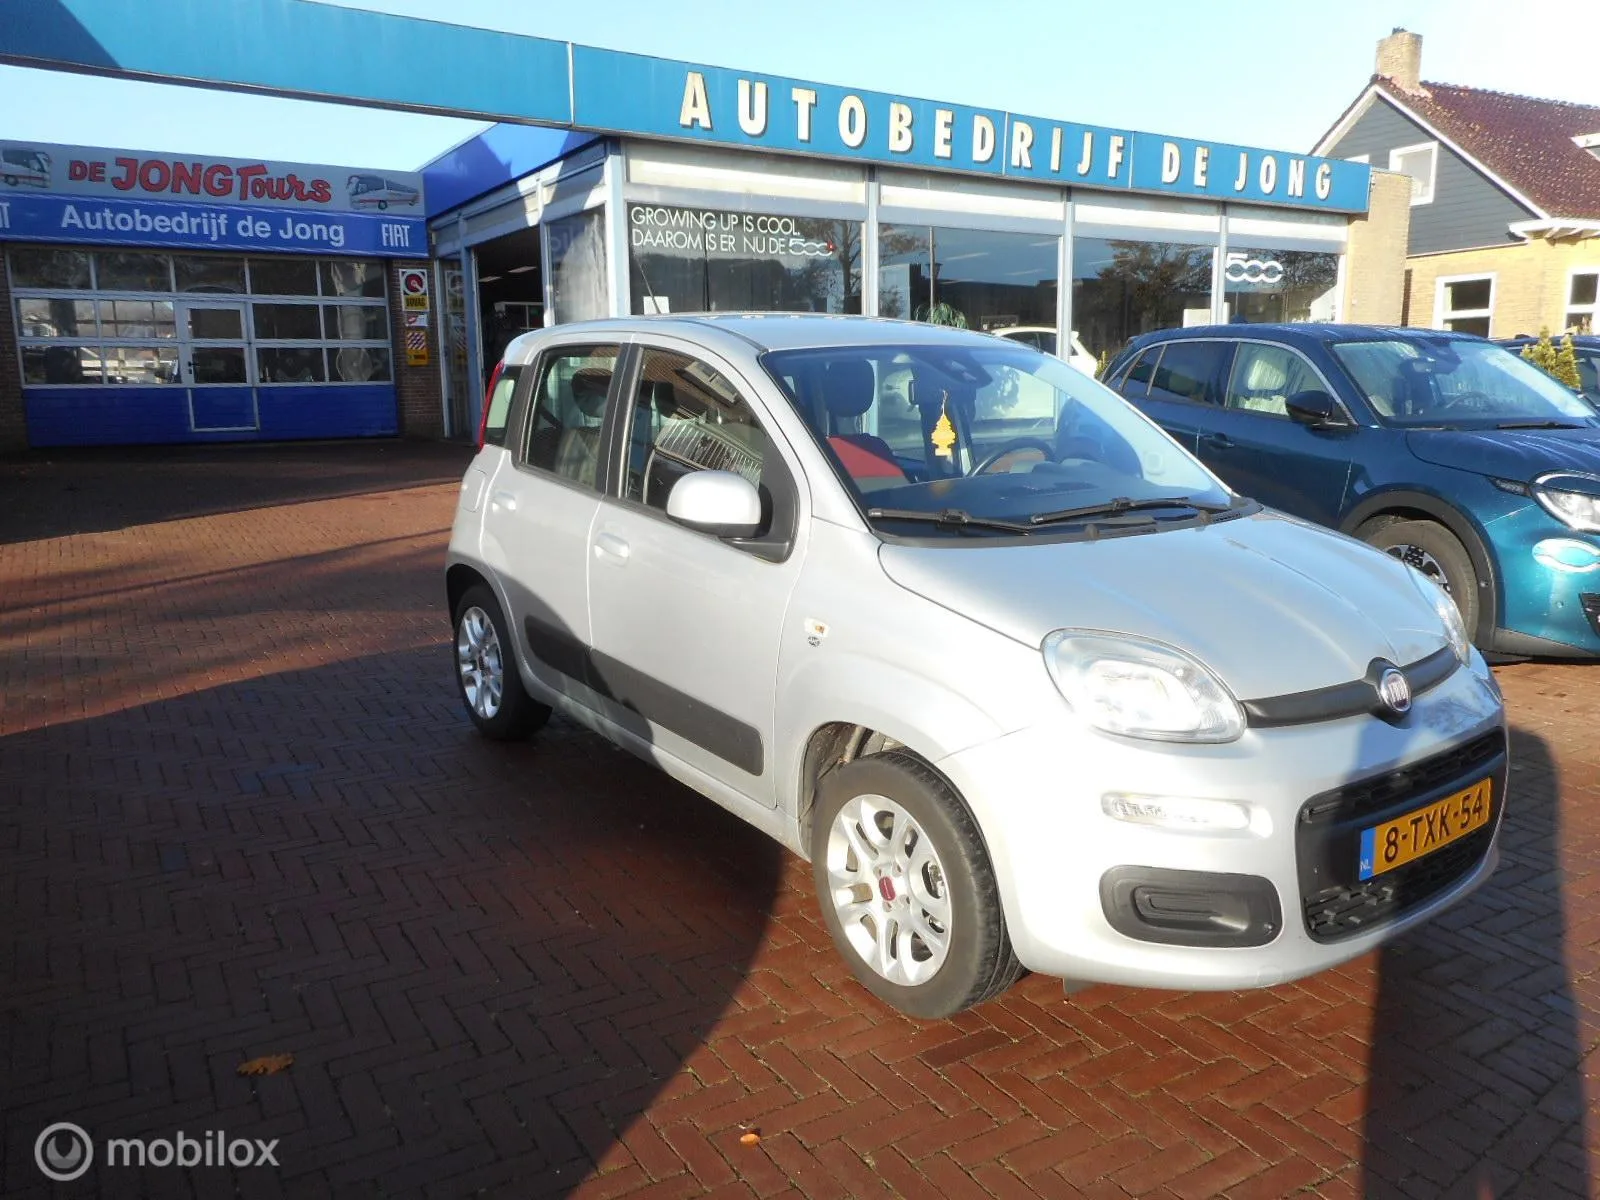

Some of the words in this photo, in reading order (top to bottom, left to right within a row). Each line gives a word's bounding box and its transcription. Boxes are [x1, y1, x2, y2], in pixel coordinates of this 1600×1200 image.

[679, 71, 1124, 178] AUTOBEDRIJF
[1161, 142, 1209, 188] DE
[1234, 151, 1331, 200] JONG
[68, 159, 106, 183] DE
[111, 156, 233, 197] JONG
[236, 163, 332, 203] Tours
[61, 204, 229, 242] Autobedrijf
[236, 215, 272, 239] de
[279, 217, 344, 248] Jong
[381, 223, 410, 248] FIAT
[631, 206, 717, 230] GROWING
[720, 213, 739, 232] UP
[743, 215, 754, 233] IS
[757, 216, 801, 236] COOL.
[632, 228, 703, 250] DAAROM
[705, 233, 717, 251] IS
[720, 234, 736, 252] ER
[743, 235, 766, 253] NU
[769, 237, 786, 255] DE
[1225, 252, 1284, 284] 500
[1384, 787, 1484, 863] 8-TXK-54
